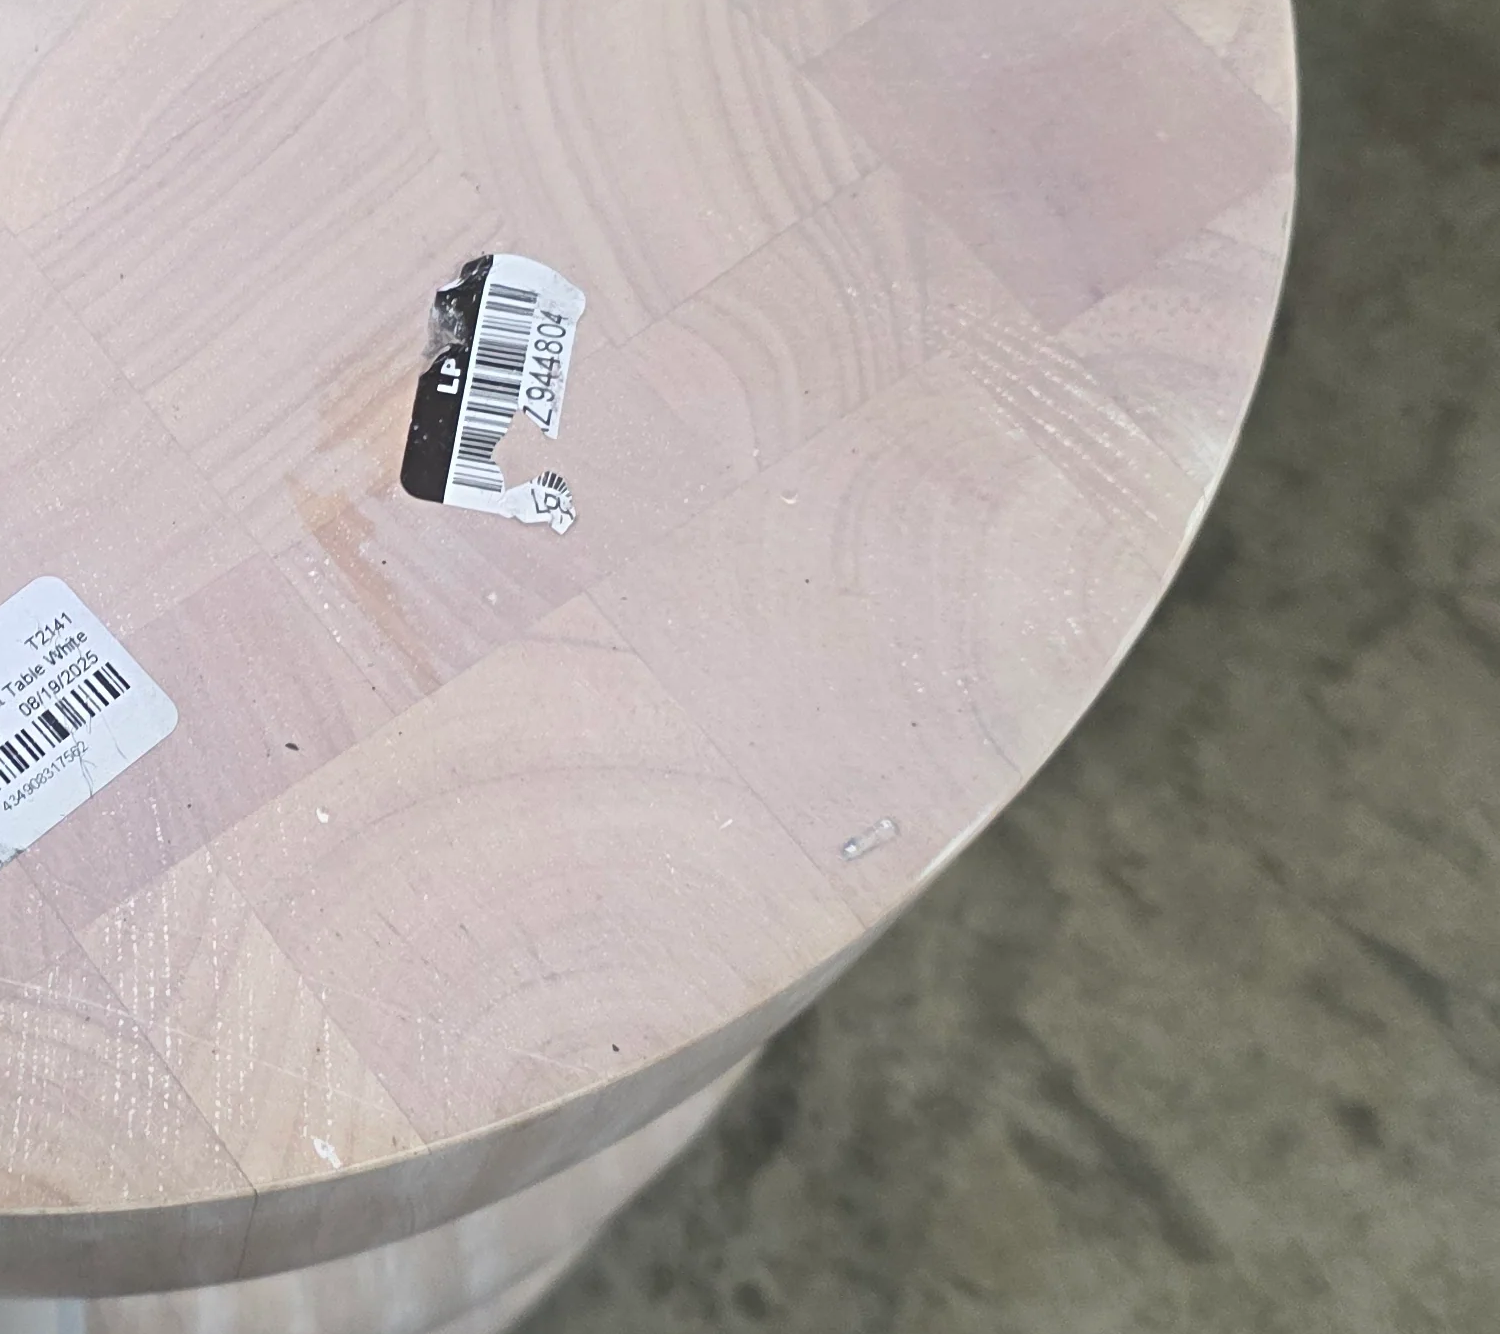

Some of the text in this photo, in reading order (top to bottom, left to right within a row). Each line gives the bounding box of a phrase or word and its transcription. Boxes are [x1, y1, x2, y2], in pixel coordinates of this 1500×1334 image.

[523, 310, 569, 434] Z944804
[1, 661, 46, 699] Table
[45, 630, 88, 667] White
[24, 612, 73, 652] T2141
[18, 650, 99, 717] 08/19/2025
